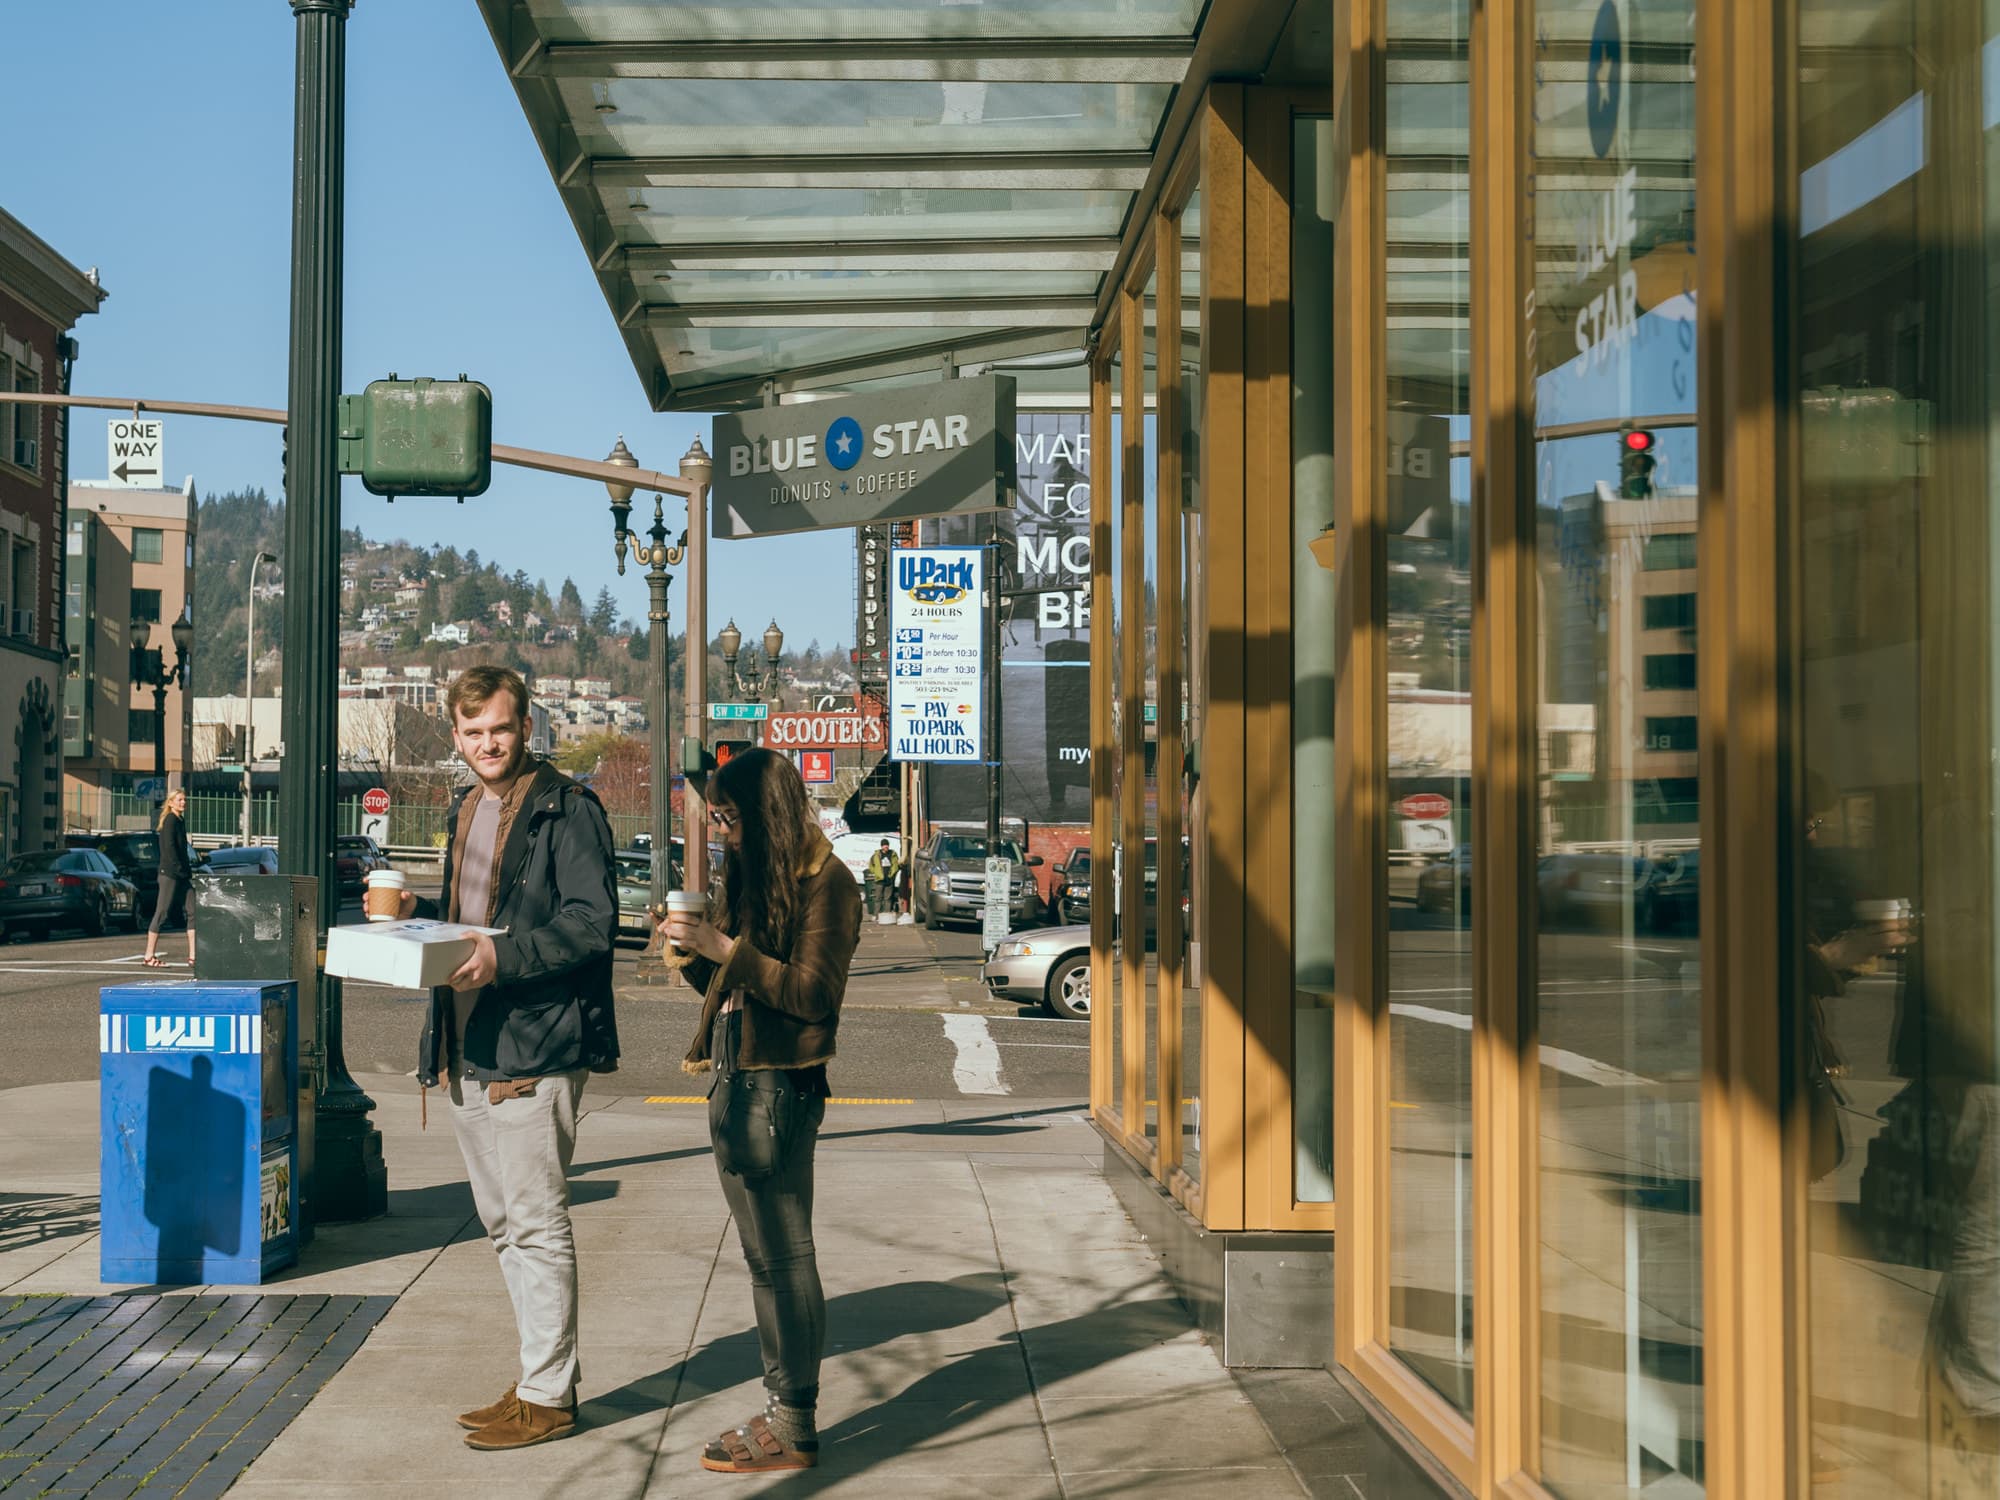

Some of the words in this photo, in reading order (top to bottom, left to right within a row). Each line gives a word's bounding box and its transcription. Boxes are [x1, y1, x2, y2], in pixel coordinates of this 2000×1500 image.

[1576, 269, 1638, 378] STAR
[114, 423, 158, 439] ONE
[114, 442, 158, 457] WAY
[729, 434, 818, 477] BLUE
[872, 414, 969, 458] STAR
[770, 480, 832, 505] DONUTS
[856, 469, 917, 495] COFFEE
[899, 557, 975, 590] U-Park
[911, 608, 923, 617] 24
[927, 607, 963, 617] HOURS
[929, 632, 940, 641] Per
[943, 632, 959, 641] Hour
[933, 648, 954, 657] before
[957, 649, 978, 657] 10:30
[933, 665, 949, 673] after
[955, 665, 976, 674] 10:30
[716, 705, 728, 717] SW
[754, 705, 765, 717] AV
[924, 701, 950, 717] PAY
[771, 716, 881, 745] SCOOTER'S
[907, 719, 926, 735] TO
[928, 719, 965, 735] PARK
[896, 738, 922, 754] ALL
[924, 738, 975, 755] HOURS
[365, 796, 388, 807] STOP
